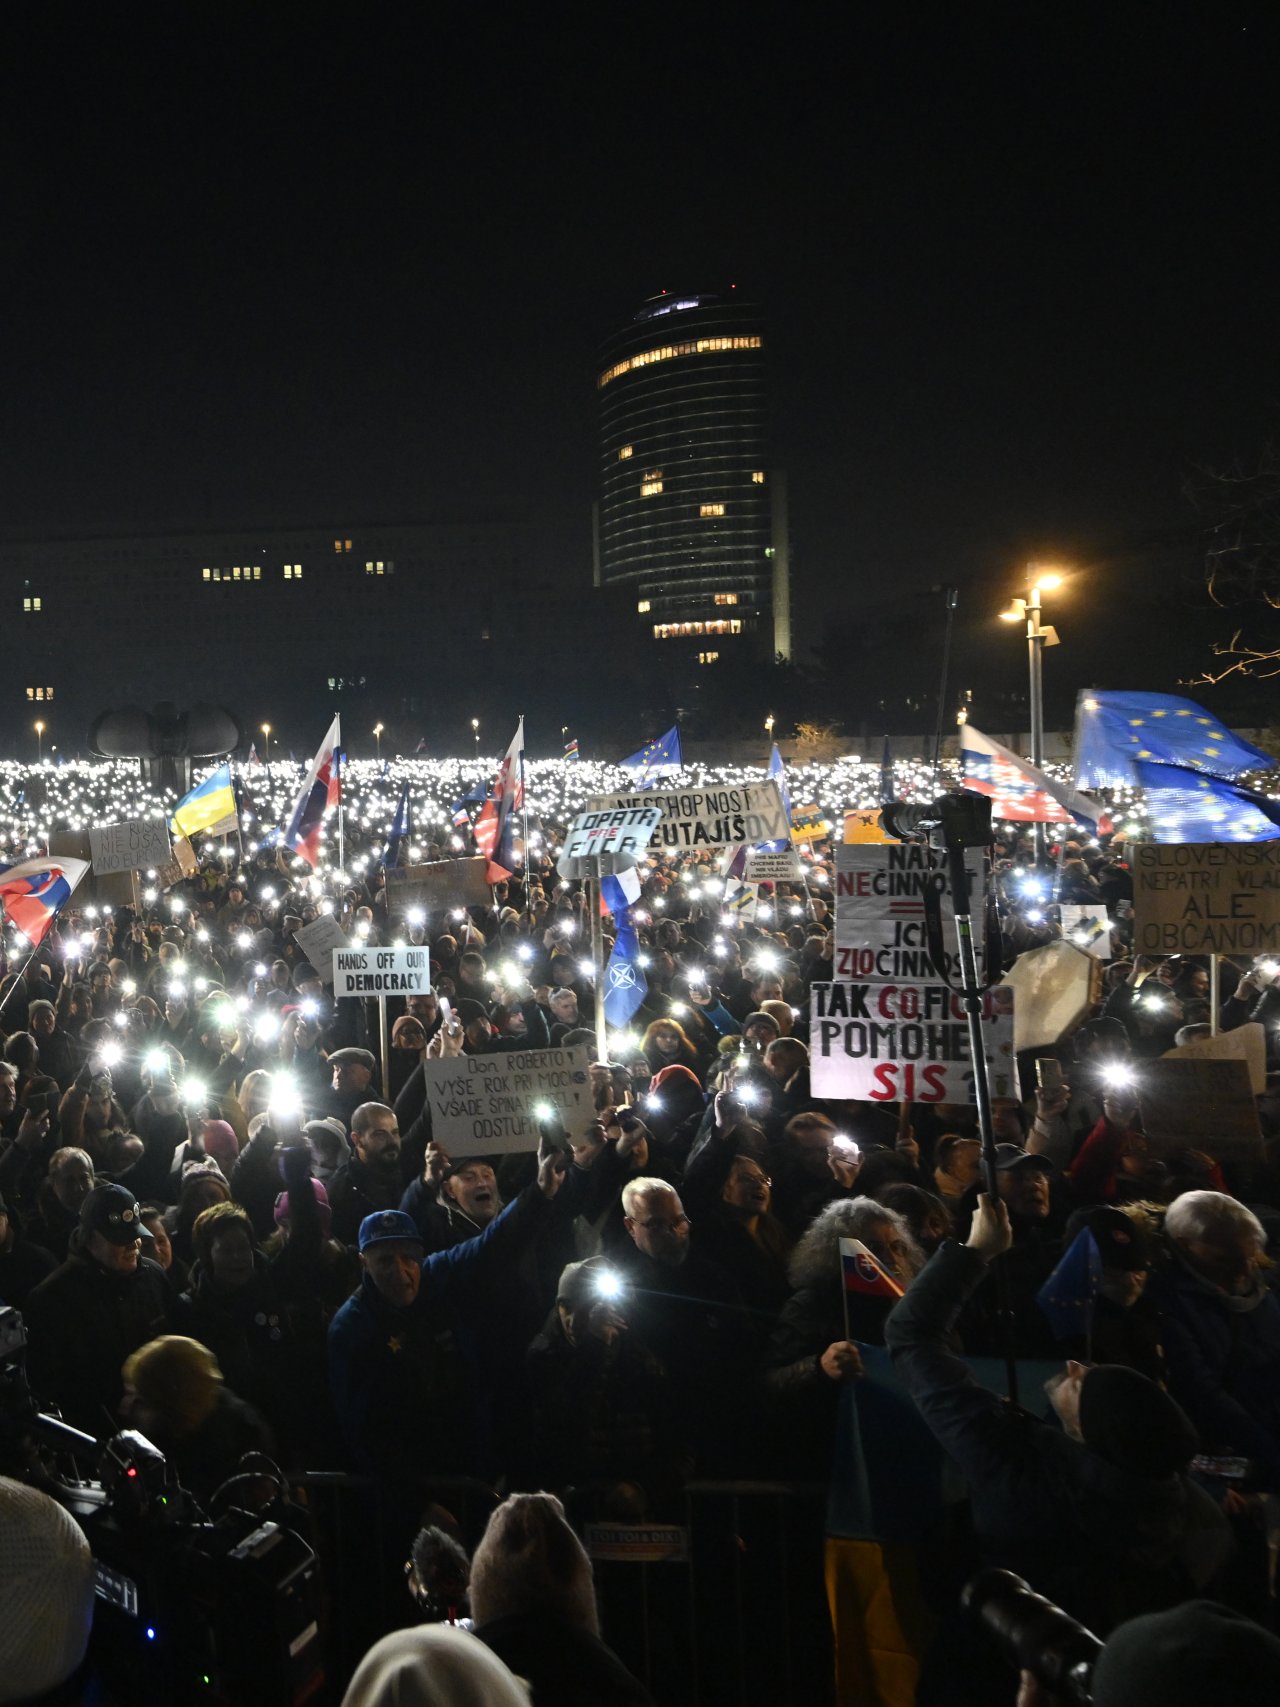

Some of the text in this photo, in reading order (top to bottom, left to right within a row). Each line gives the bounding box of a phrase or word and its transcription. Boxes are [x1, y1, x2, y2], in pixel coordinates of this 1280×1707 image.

[571, 809, 656, 833] LOPATA
[129, 833, 162, 850] USA
[587, 827, 620, 840] PRE
[837, 868, 978, 897] NEČINNOŤ
[1182, 893, 1256, 919] ALE
[337, 952, 426, 970] HANDS OFF OUR
[346, 973, 423, 991] DEMOCRACY
[813, 983, 871, 1018] TAK
[821, 1020, 993, 1063] POMOHE
[435, 1076, 475, 1096] VYŠE
[484, 1076, 511, 1094] ROK
[514, 1074, 533, 1092] PRI
[868, 1063, 948, 1103] SIS
[437, 1094, 484, 1118] VŠADE
[489, 1093, 524, 1114] ŠPINA
